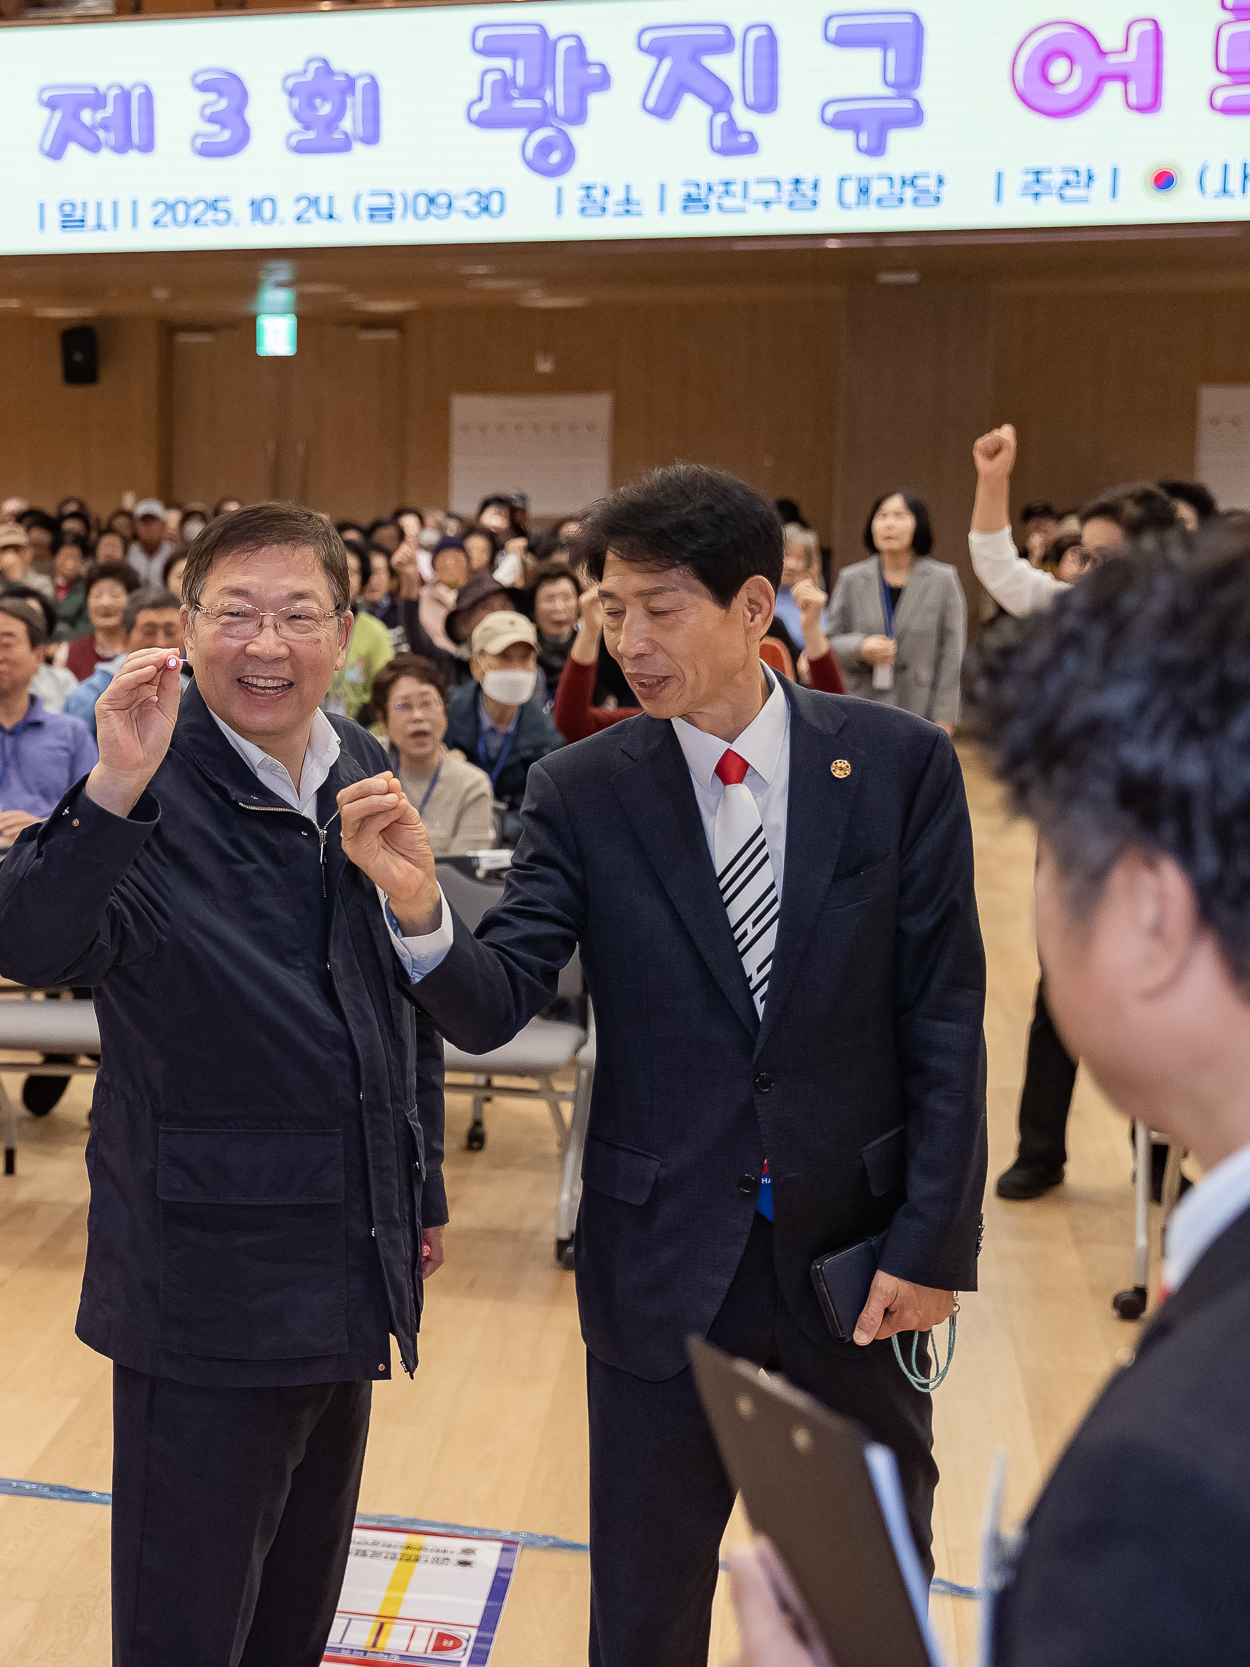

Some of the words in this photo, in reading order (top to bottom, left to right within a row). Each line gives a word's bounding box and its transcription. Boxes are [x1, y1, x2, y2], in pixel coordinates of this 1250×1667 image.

[467, 11, 924, 178] 광진구
[579, 183, 643, 218] 장소
[680, 176, 821, 216] 광진구청
[837, 171, 946, 210] 대강당
[1020, 167, 1095, 205] 주관
[58, 200, 119, 233] 일시
